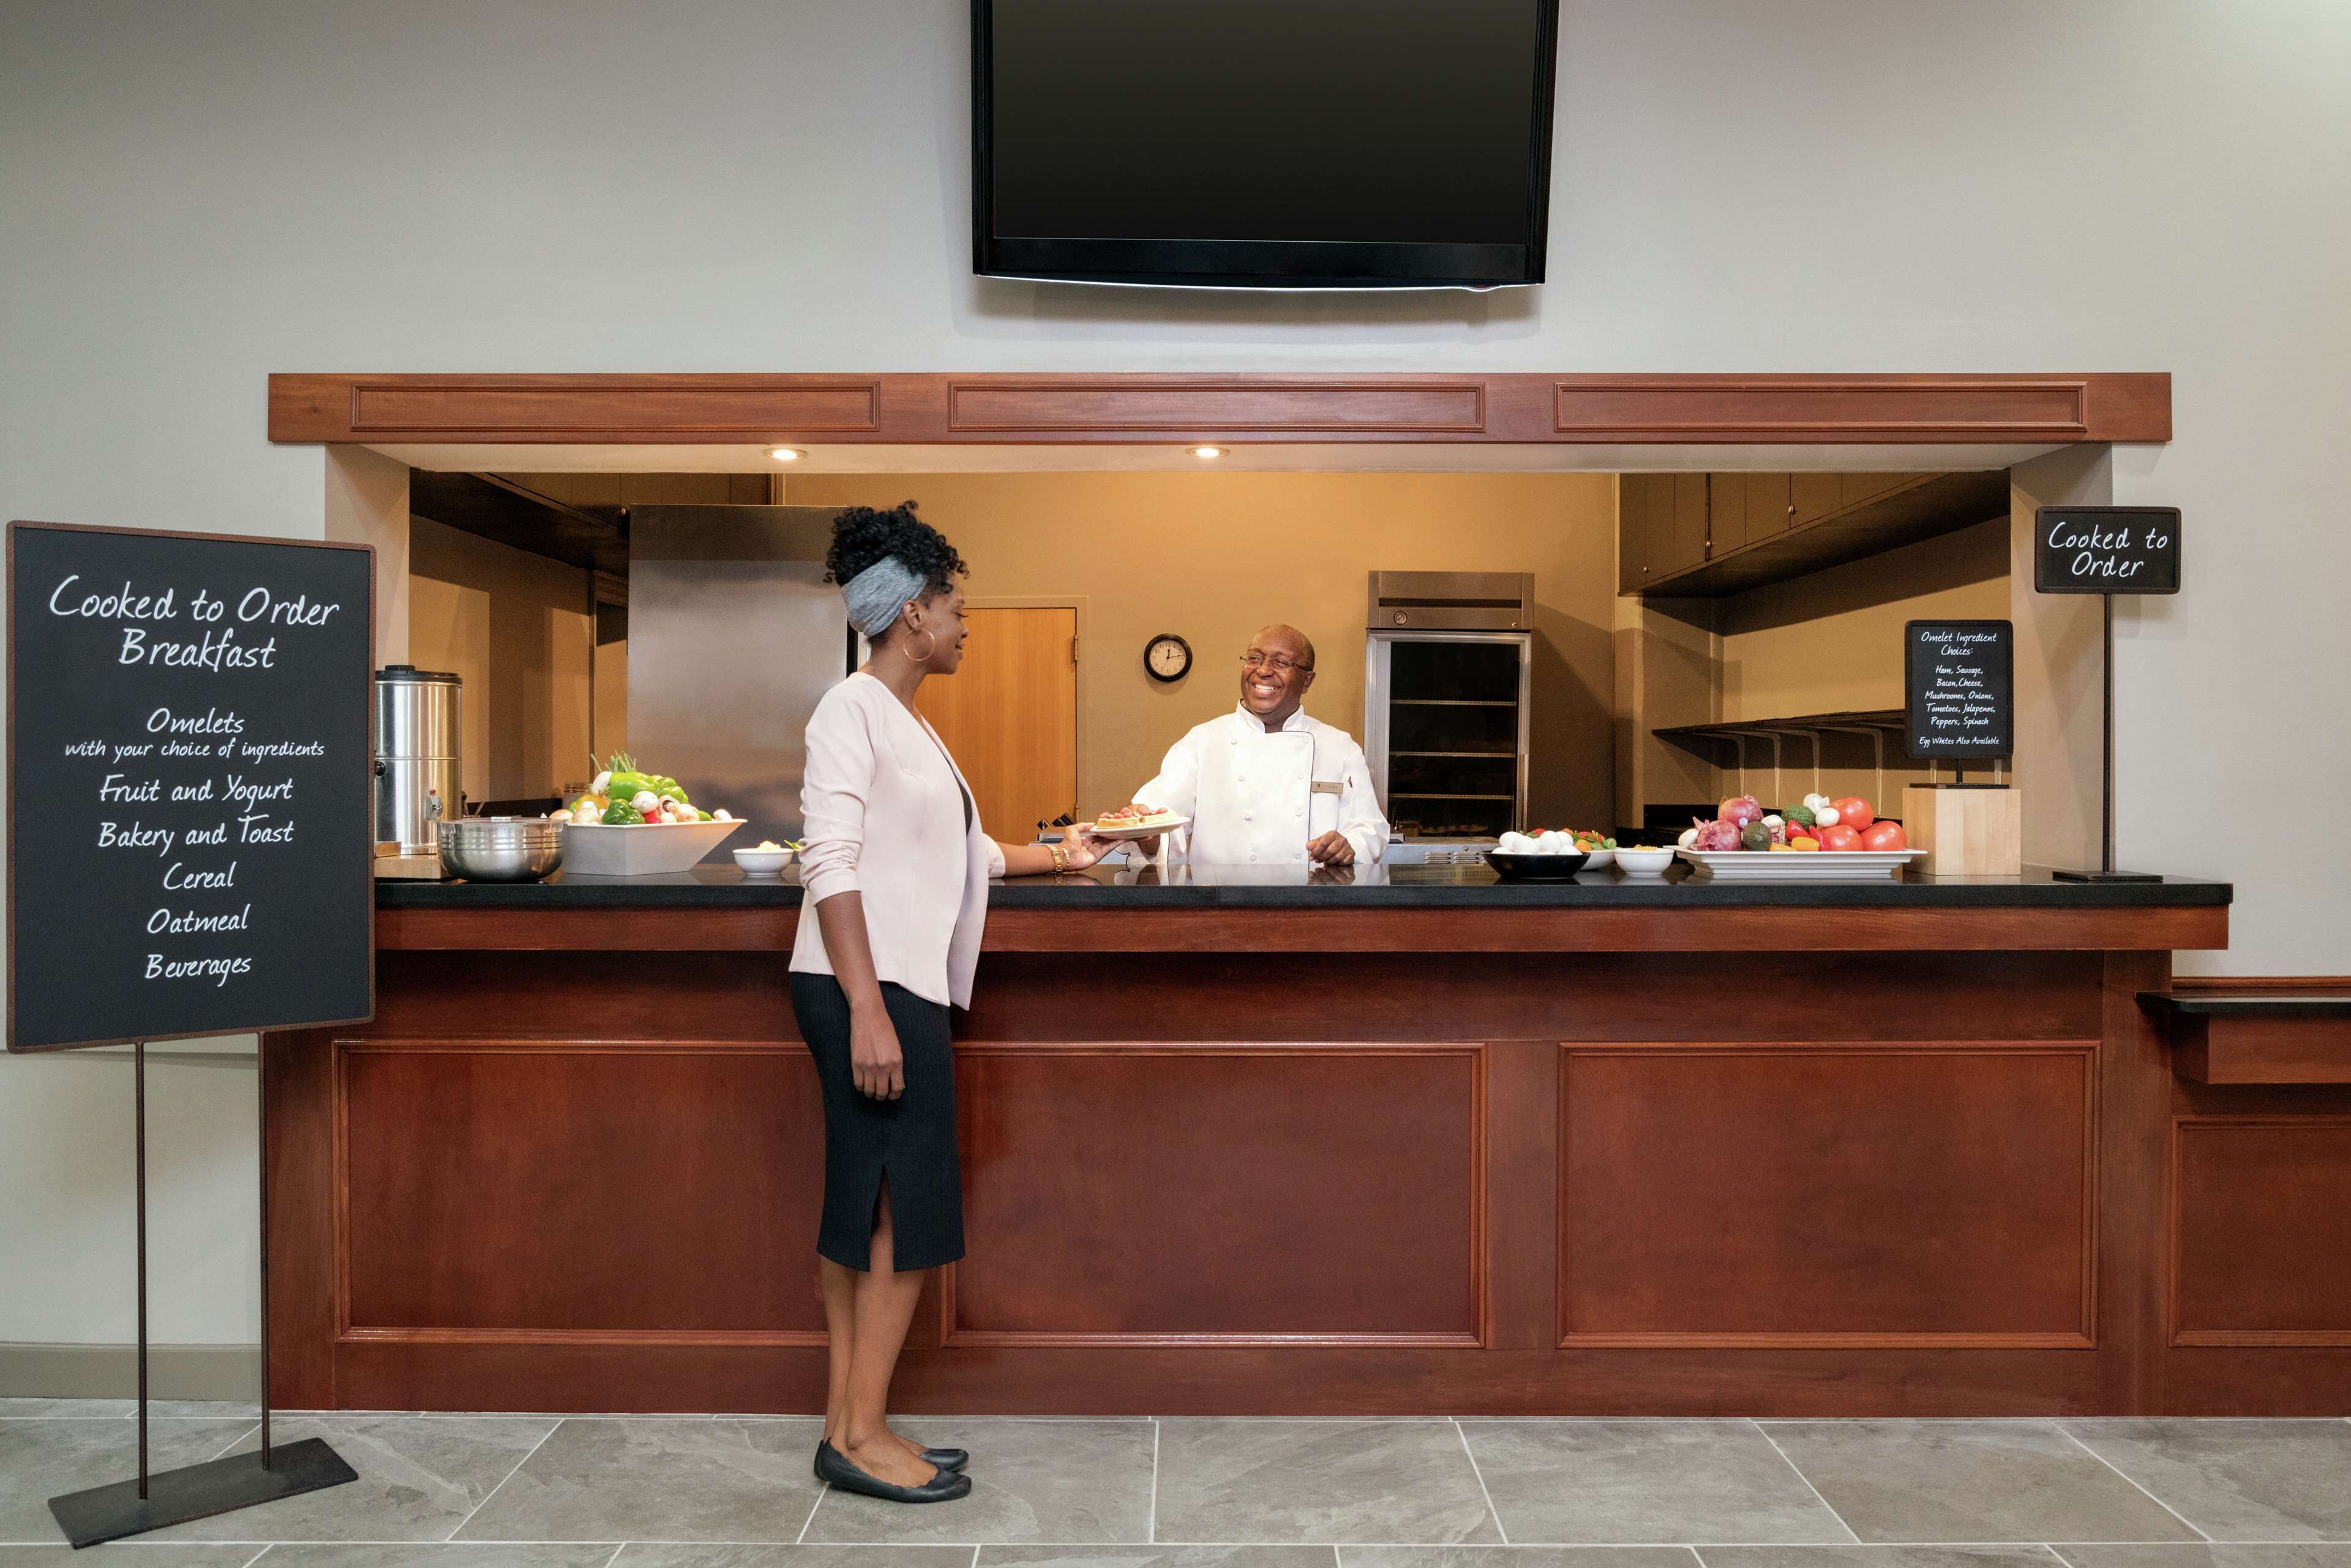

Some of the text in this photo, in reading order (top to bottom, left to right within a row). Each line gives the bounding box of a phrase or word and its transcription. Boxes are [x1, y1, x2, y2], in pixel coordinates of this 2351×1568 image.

[2049, 522, 2167, 549] Cooked to
[2072, 552, 2143, 577] Order
[50, 575, 339, 625] Cooked to Order
[119, 628, 276, 672] Breakfast
[1921, 631, 1997, 647] Omelet Ingredient
[1936, 665, 1982, 677] Ham, Sausage,
[1925, 691, 1993, 700] Mushrooms, Onions,
[1926, 703, 1960, 713] Tomatoes,
[147, 708, 244, 734] Omelets
[1931, 716, 1989, 729] Peppers, Spinach
[66, 737, 324, 764] with your choice of ingredients
[1919, 737, 1930, 748] Egg
[100, 774, 293, 812] Fruit and Yogurt
[98, 814, 294, 856] Bakery and Toast
[163, 861, 234, 890] Cereal
[147, 904, 250, 934] Oatmeal
[145, 955, 252, 987] Beverages
